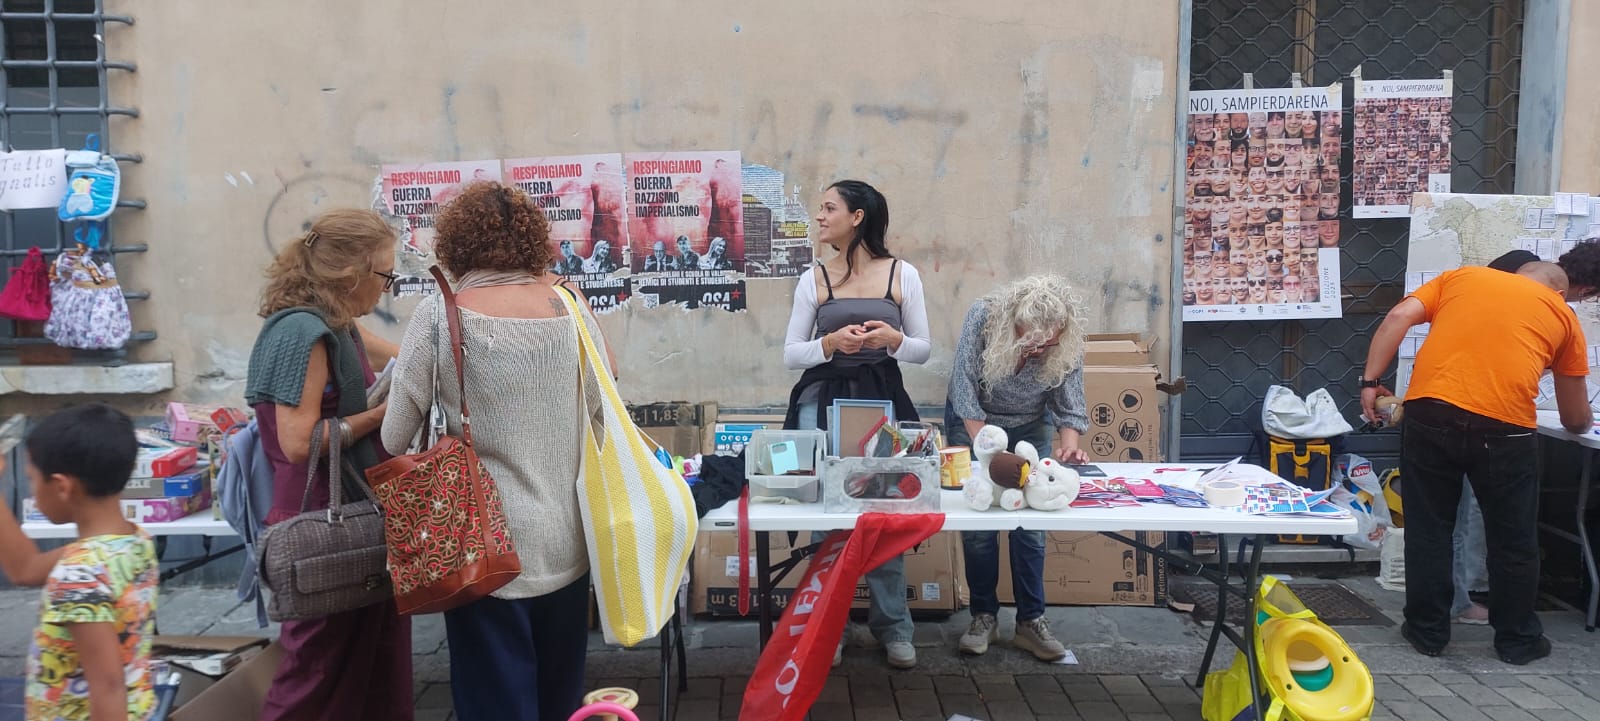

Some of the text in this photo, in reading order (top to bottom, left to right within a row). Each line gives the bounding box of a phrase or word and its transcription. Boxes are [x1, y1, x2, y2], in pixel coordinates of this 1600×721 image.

[1190, 95, 1329, 112] NOI, SAMPIERDARENA
[512, 163, 582, 180] RESPINGIAMO
[633, 160, 702, 174] RESPINGIAMO
[391, 169, 461, 186] RESPINGIAMO
[634, 176, 673, 190] GUERRA
[392, 187, 432, 202] GUERRA
[635, 192, 680, 204] RAZZISMO
[393, 202, 440, 216] RAZZISMO
[635, 205, 700, 218] IMPERIALISMO
[667, 278, 695, 287] STUDENTI
